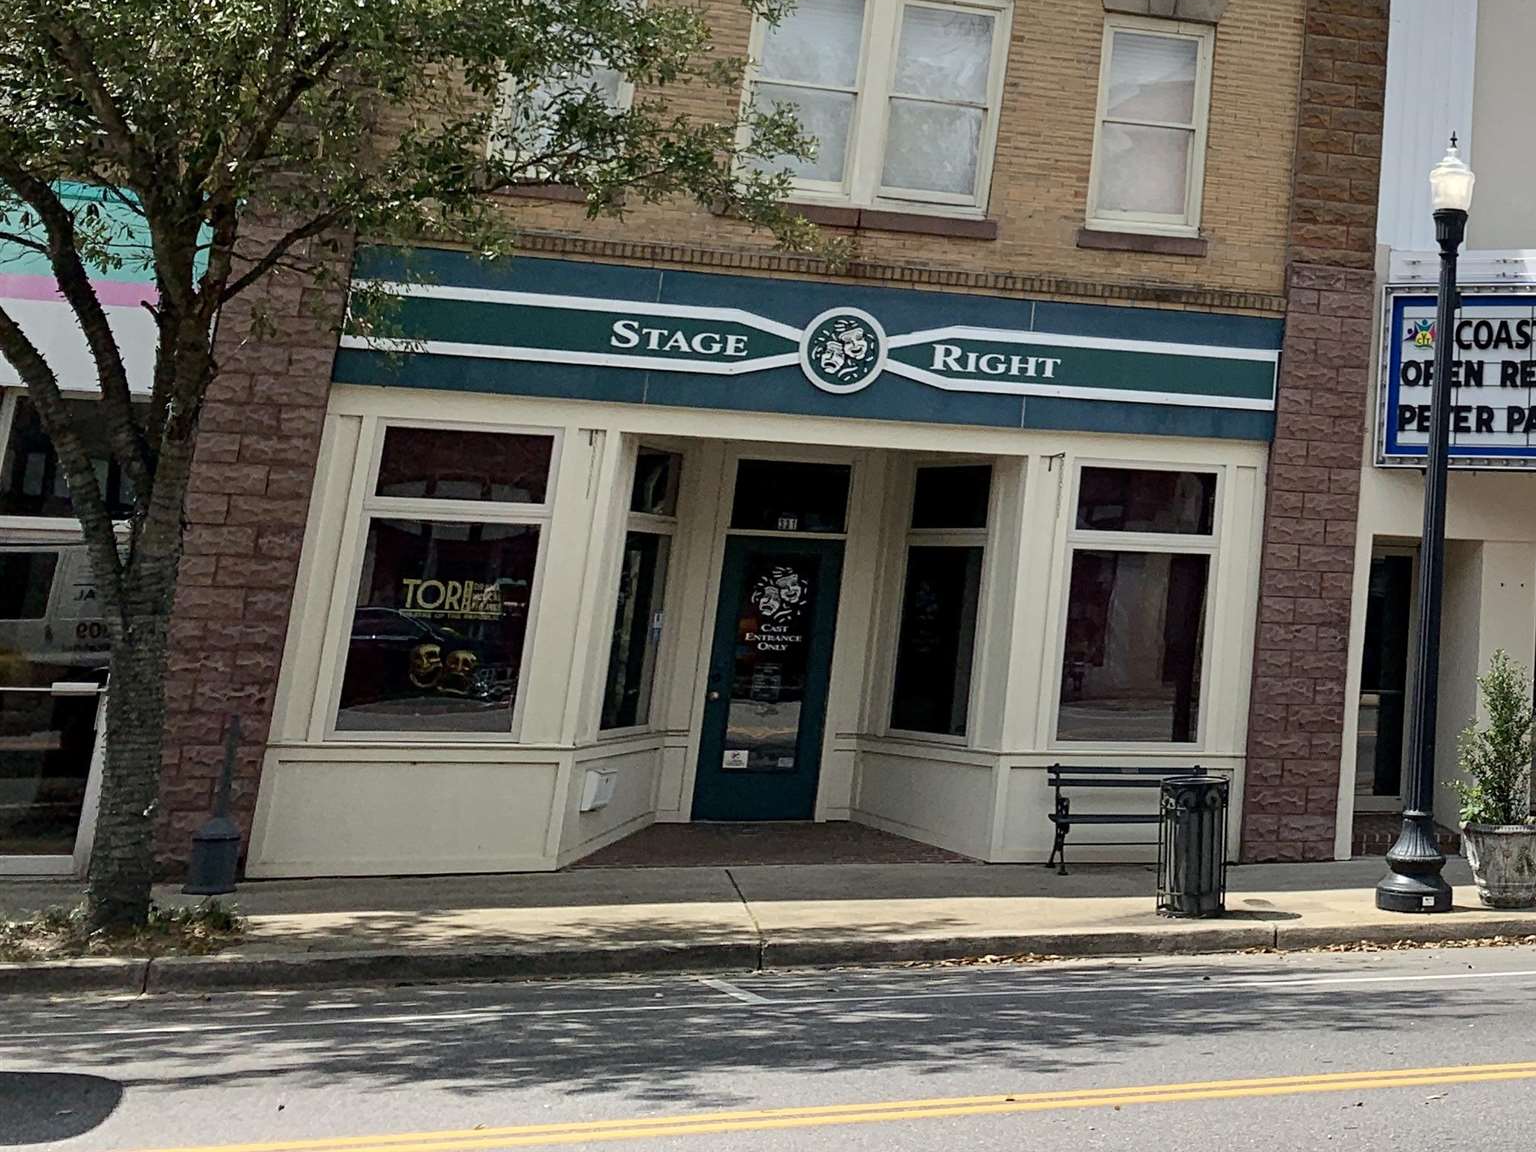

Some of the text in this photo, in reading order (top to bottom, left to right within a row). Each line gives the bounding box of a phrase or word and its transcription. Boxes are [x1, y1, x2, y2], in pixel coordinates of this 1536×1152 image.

[610, 320, 1063, 379] STAGE RIGHT
[1397, 404, 1494, 433] PEER
[761, 623, 789, 633] CAST
[744, 632, 802, 643] ENTRANCE
[757, 641, 789, 651] ONLY
